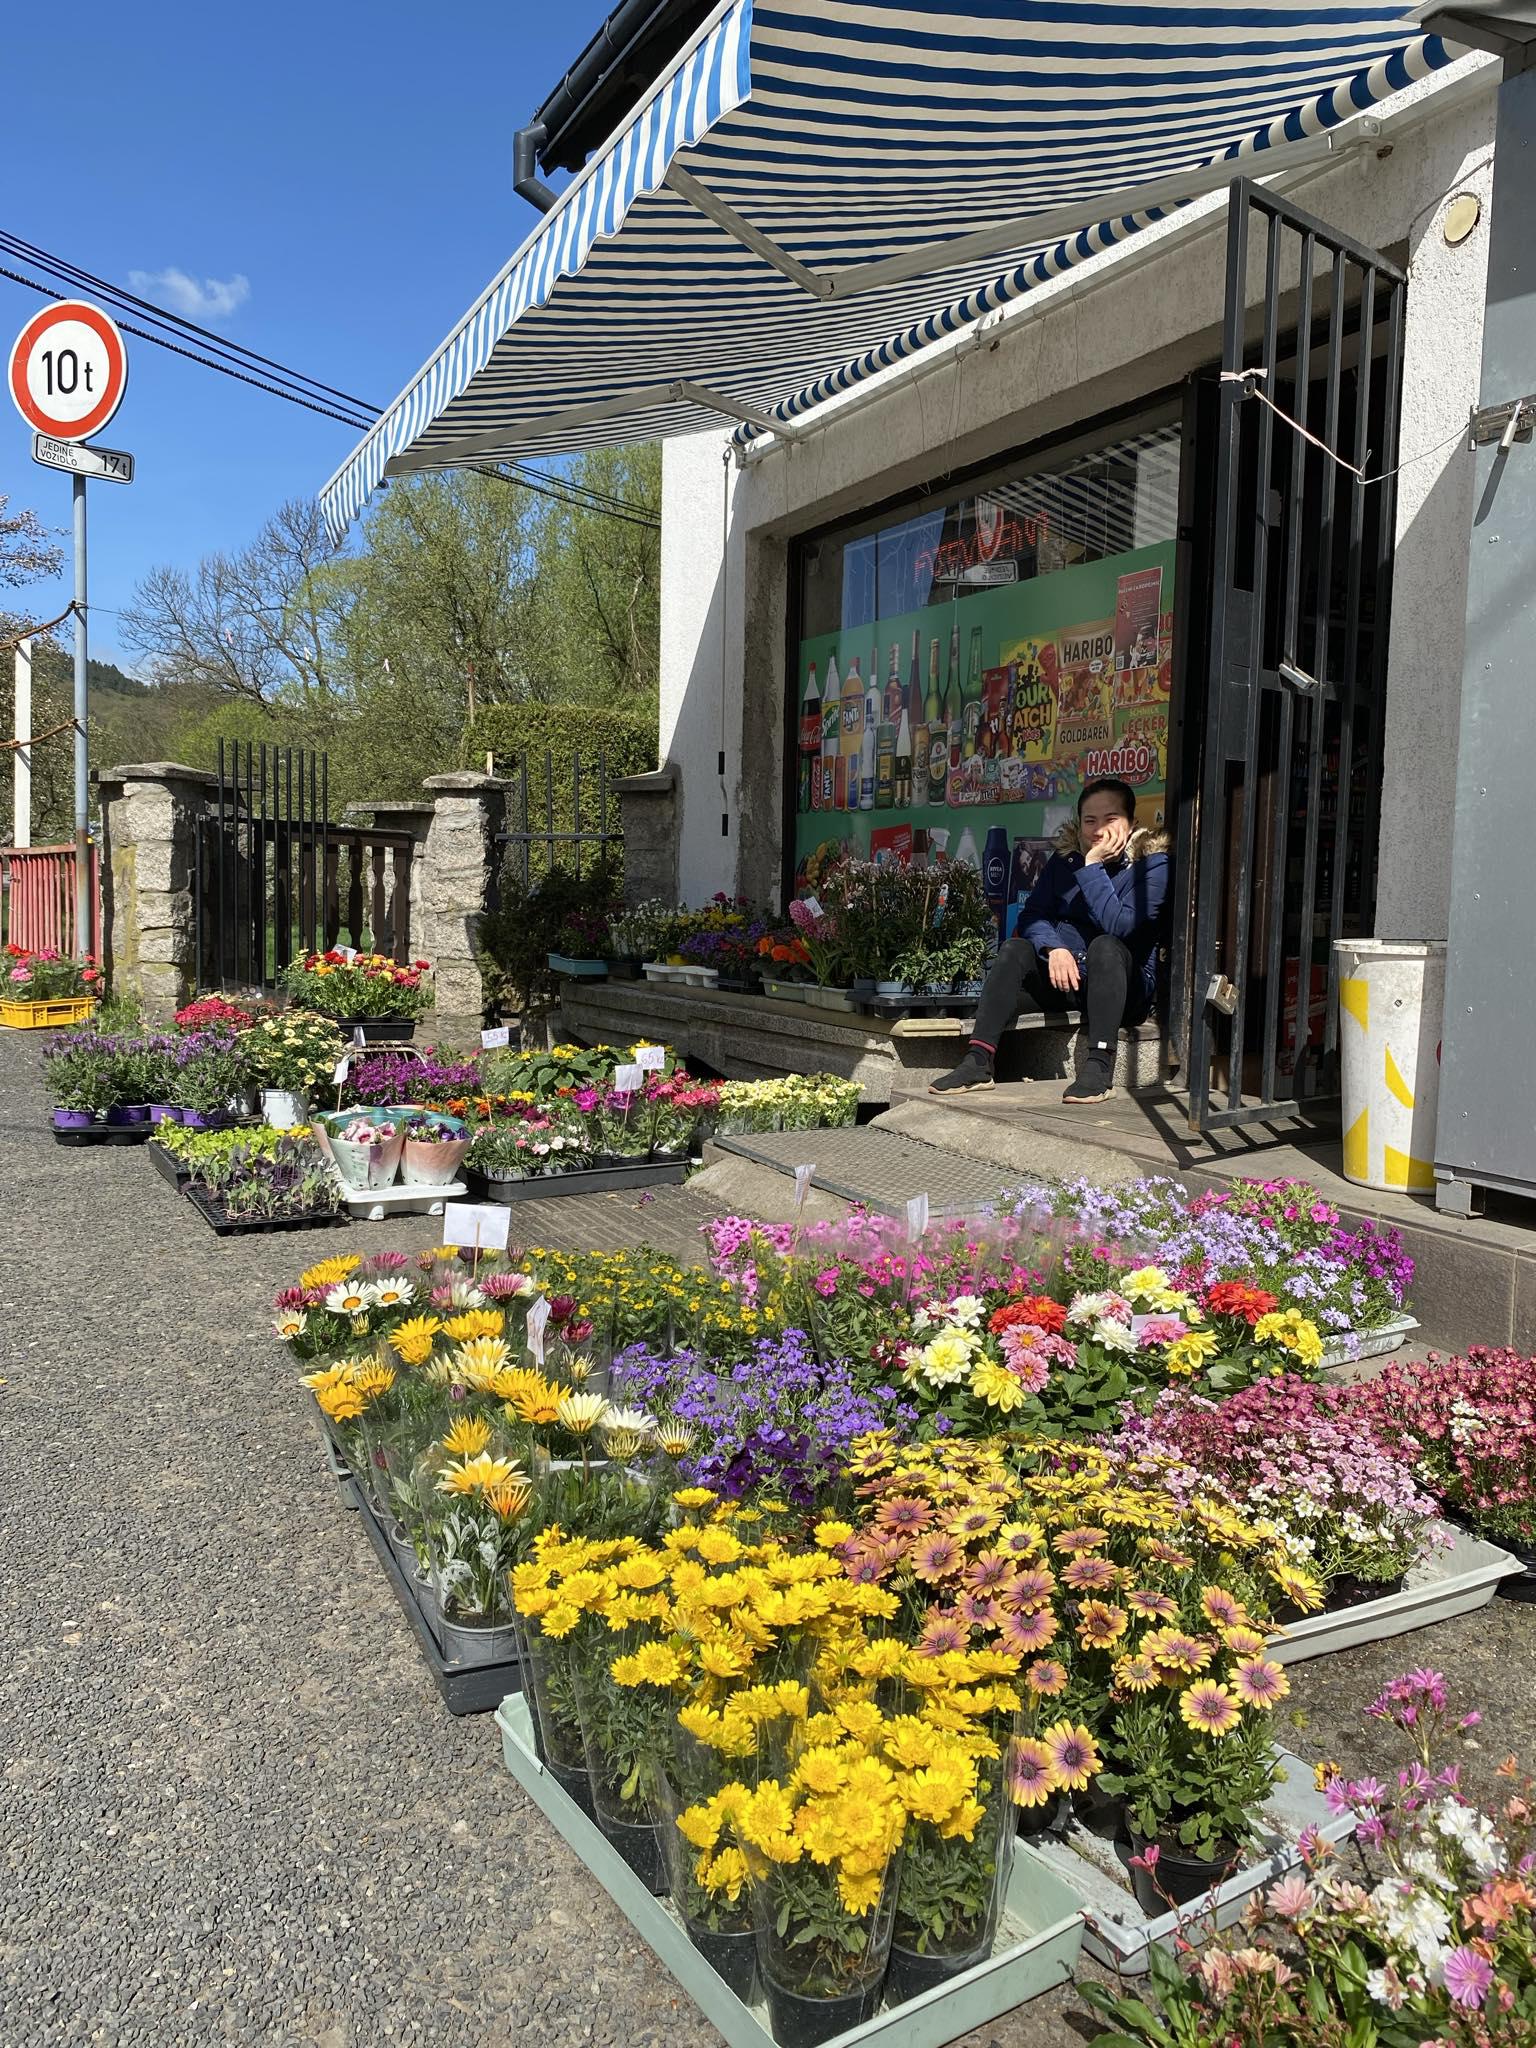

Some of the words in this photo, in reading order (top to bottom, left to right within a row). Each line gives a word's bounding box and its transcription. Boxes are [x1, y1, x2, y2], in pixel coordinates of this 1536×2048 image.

[42, 349, 78, 395] 10
[84, 362, 93, 392] t
[40, 449, 77, 466] VOZIDLO
[102, 455, 119, 473] 17
[1063, 635, 1113, 663] HARIBO
[1016, 684, 1049, 706] OUR
[1014, 704, 1051, 727] ATCH
[1121, 715, 1166, 733] LECKER
[1088, 747, 1149, 776] HARIBO
